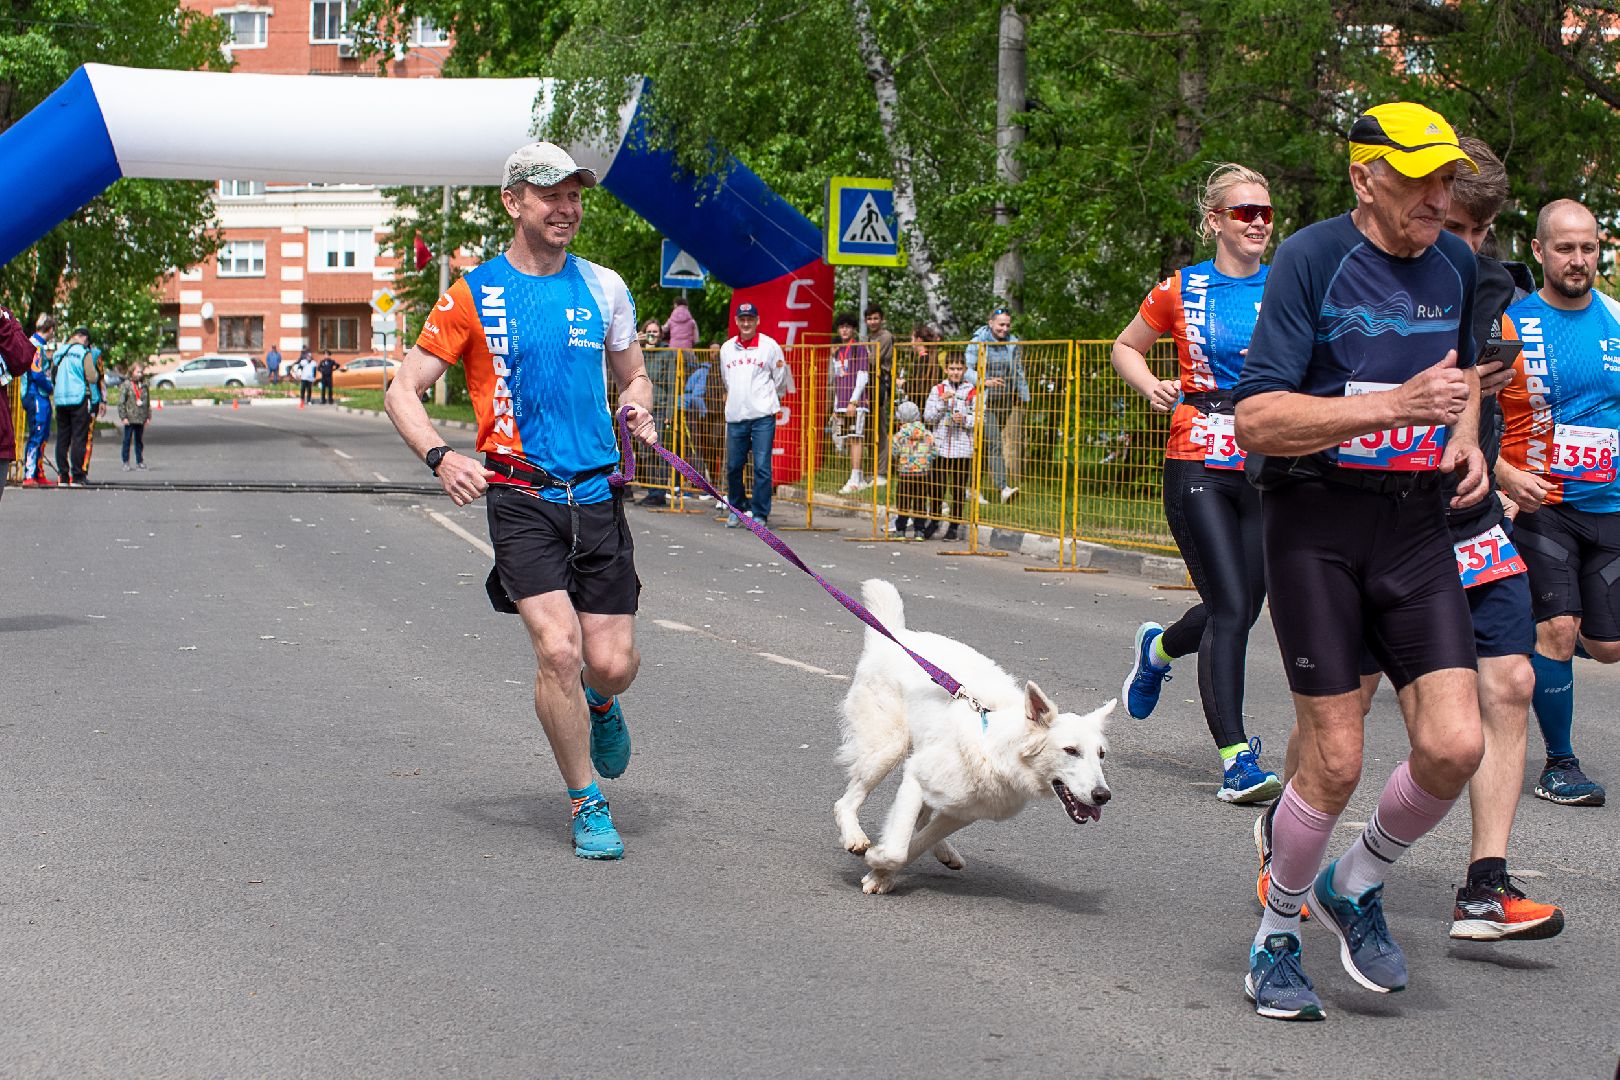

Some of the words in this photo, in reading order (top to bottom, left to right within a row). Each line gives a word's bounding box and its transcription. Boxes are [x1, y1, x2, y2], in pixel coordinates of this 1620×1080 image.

[1417, 304, 1442, 318] RUN
[509, 318, 518, 334] club
[568, 324, 587, 337] Igor
[1183, 273, 1215, 389] ZEPPELIN
[481, 285, 514, 438] ZEPPELIN
[1546, 343, 1554, 358] club
[1520, 317, 1555, 435] ZEPPELIN
[1549, 358, 1559, 383] running
[1524, 438, 1547, 474] UN
[1563, 445, 1612, 470] 358
[1457, 538, 1500, 574] 37
